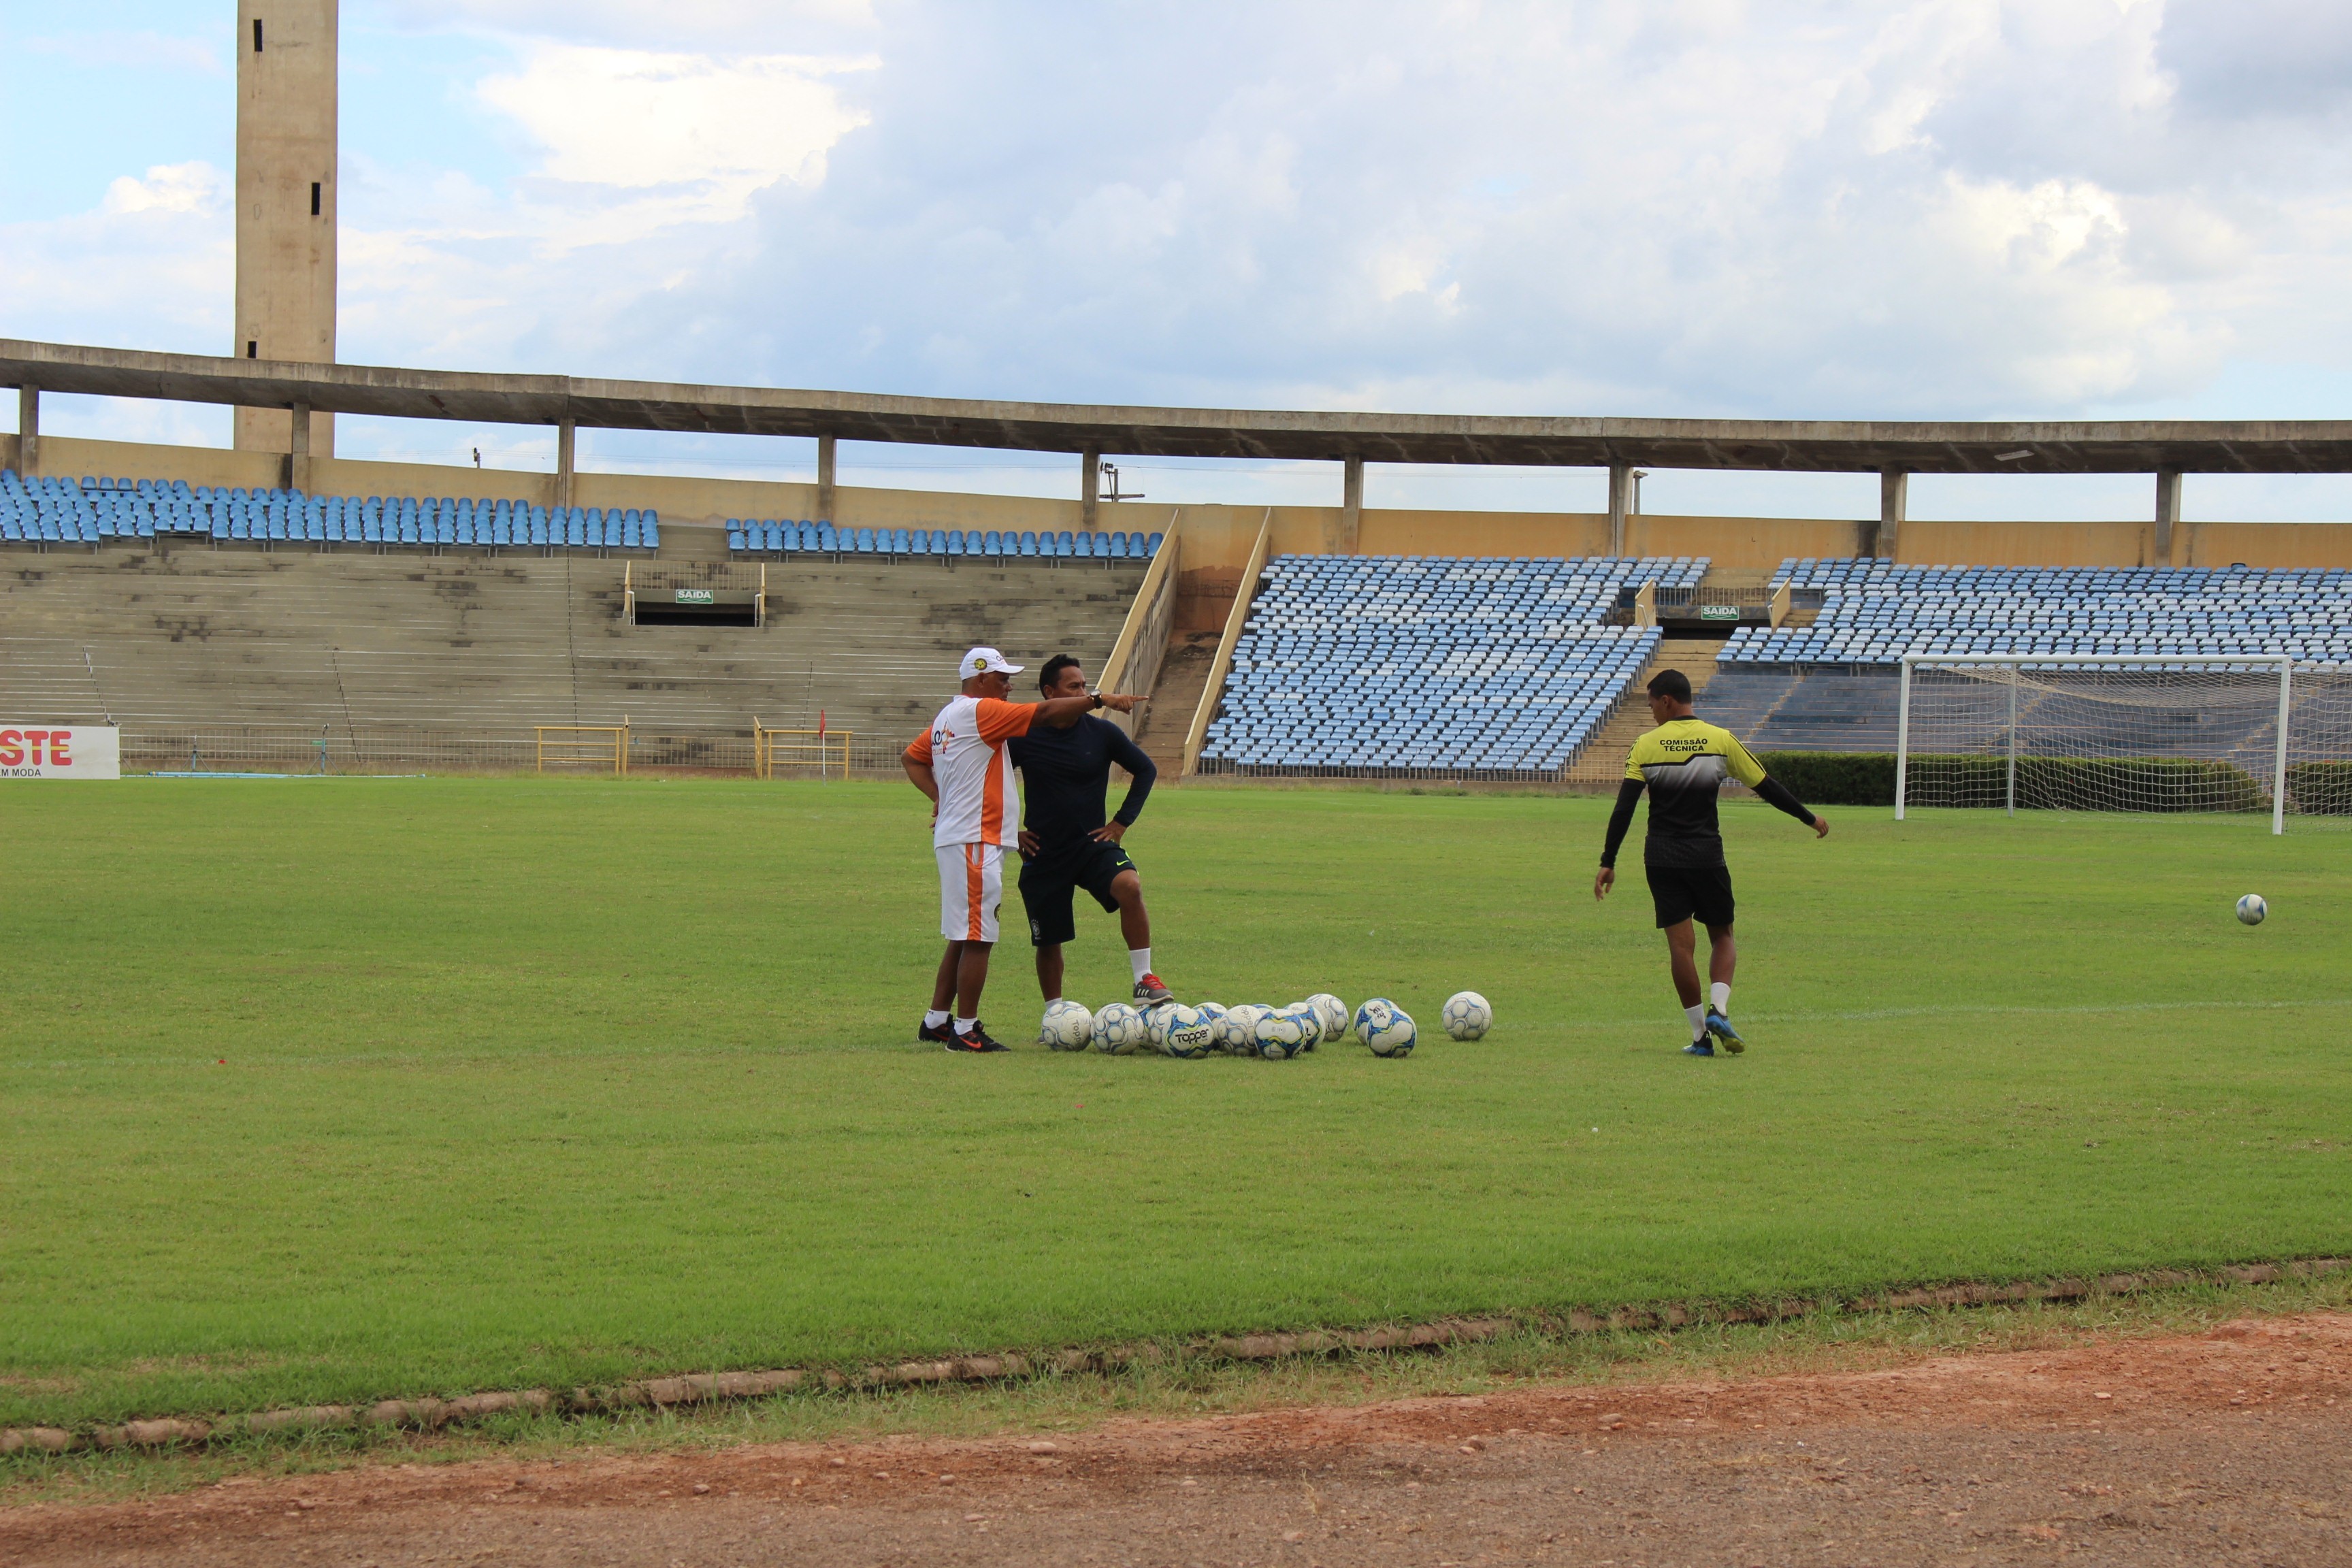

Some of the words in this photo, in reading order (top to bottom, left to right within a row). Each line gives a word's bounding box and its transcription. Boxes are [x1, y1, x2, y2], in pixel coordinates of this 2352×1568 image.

[1659, 738, 1708, 746] COMISSÃO
[12, 768, 42, 777] MODA
[1175, 1028, 1209, 1045] Topper
